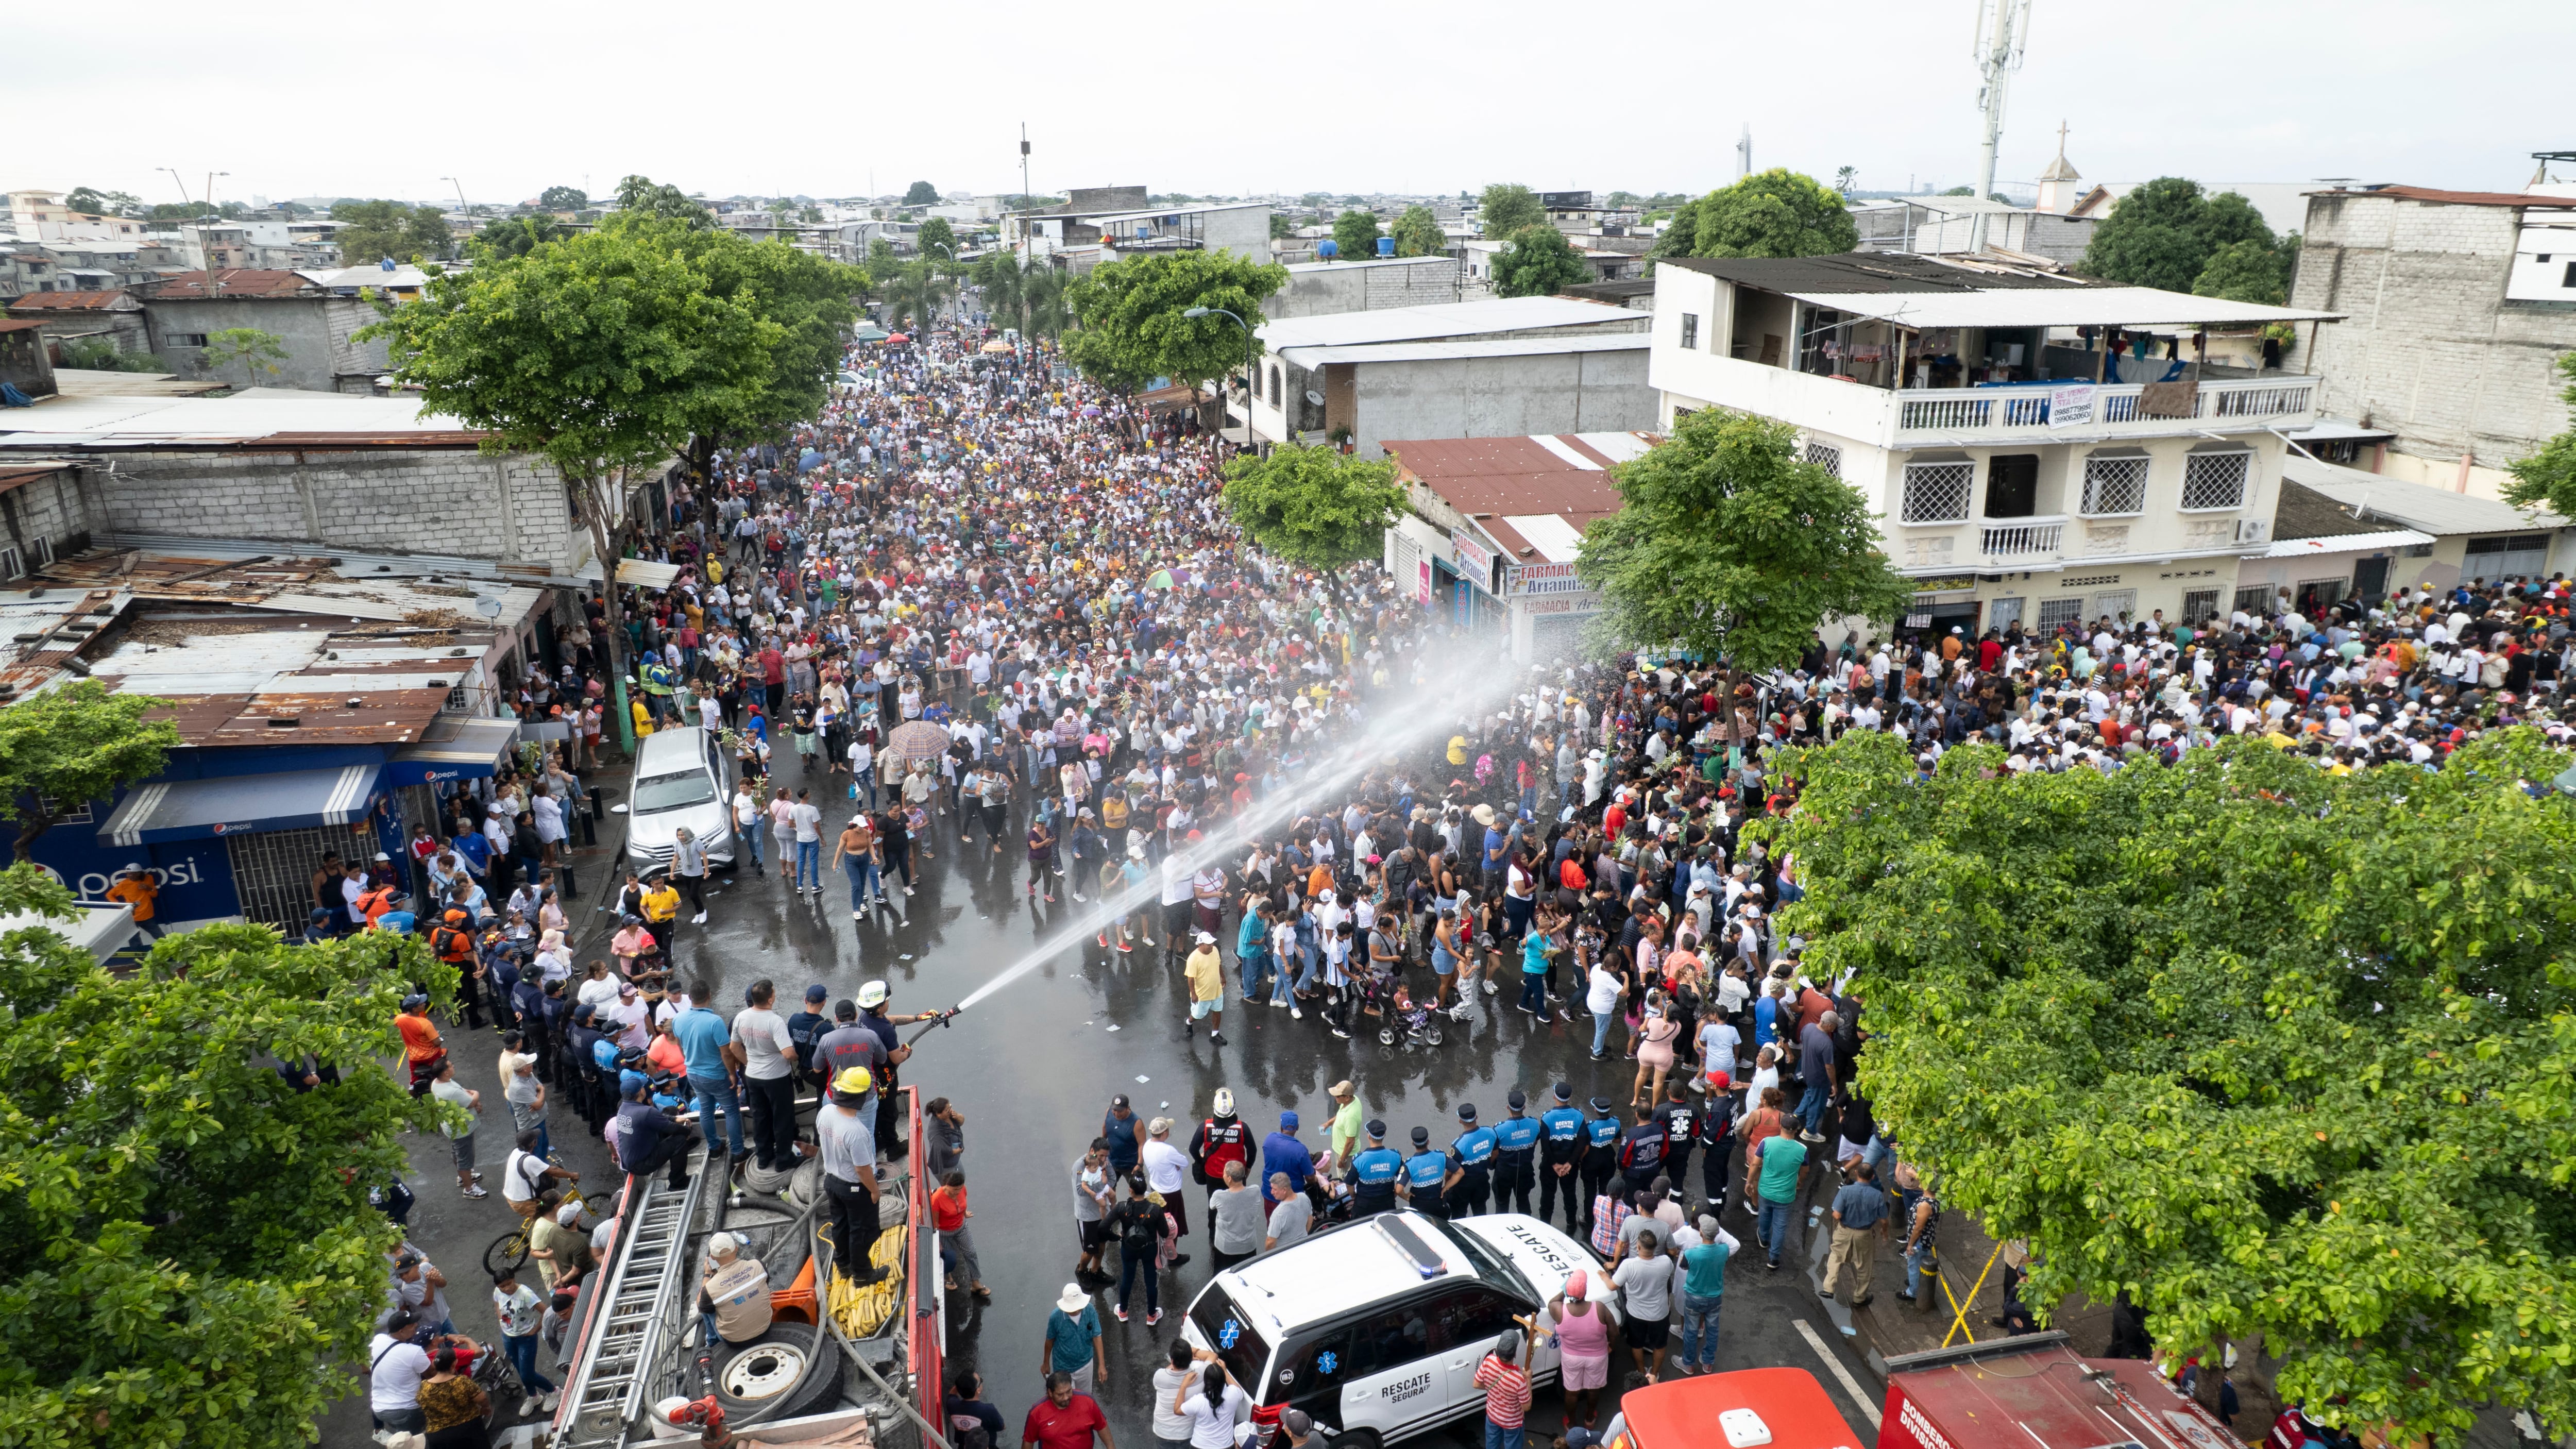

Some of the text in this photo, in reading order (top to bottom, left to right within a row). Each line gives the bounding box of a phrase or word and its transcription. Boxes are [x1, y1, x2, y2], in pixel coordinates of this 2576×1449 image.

[2052, 399, 2071, 409] ESTA
[1457, 533, 1486, 567] FARMACIA
[1460, 553, 1485, 586] Arianna
[1521, 564, 1578, 579] FARMACI
[1528, 579, 1585, 593] Arianna
[1458, 584, 1466, 623] FARMACI
[1524, 600, 1570, 614] FARMACIA
[1647, 652, 1682, 662] TENION
[437, 770, 458, 779] pepsi
[228, 822, 252, 832] pepsi
[836, 1043, 868, 1055] BCBG
[1670, 1109, 1692, 1118] EMERGENCIAS
[1473, 1139, 1489, 1150] AGENTE
[1419, 1165, 1438, 1174] AGENTE
[1506, 1225, 1574, 1278] RESCATE
[733, 1274, 751, 1285] PRENSA
[1382, 1372, 1430, 1398] RESCATE
[1392, 1386, 1424, 1404] SEGURA
[1900, 1411, 1939, 1449] DIVISIO
[1903, 1397, 1955, 1449] BOMBERO
